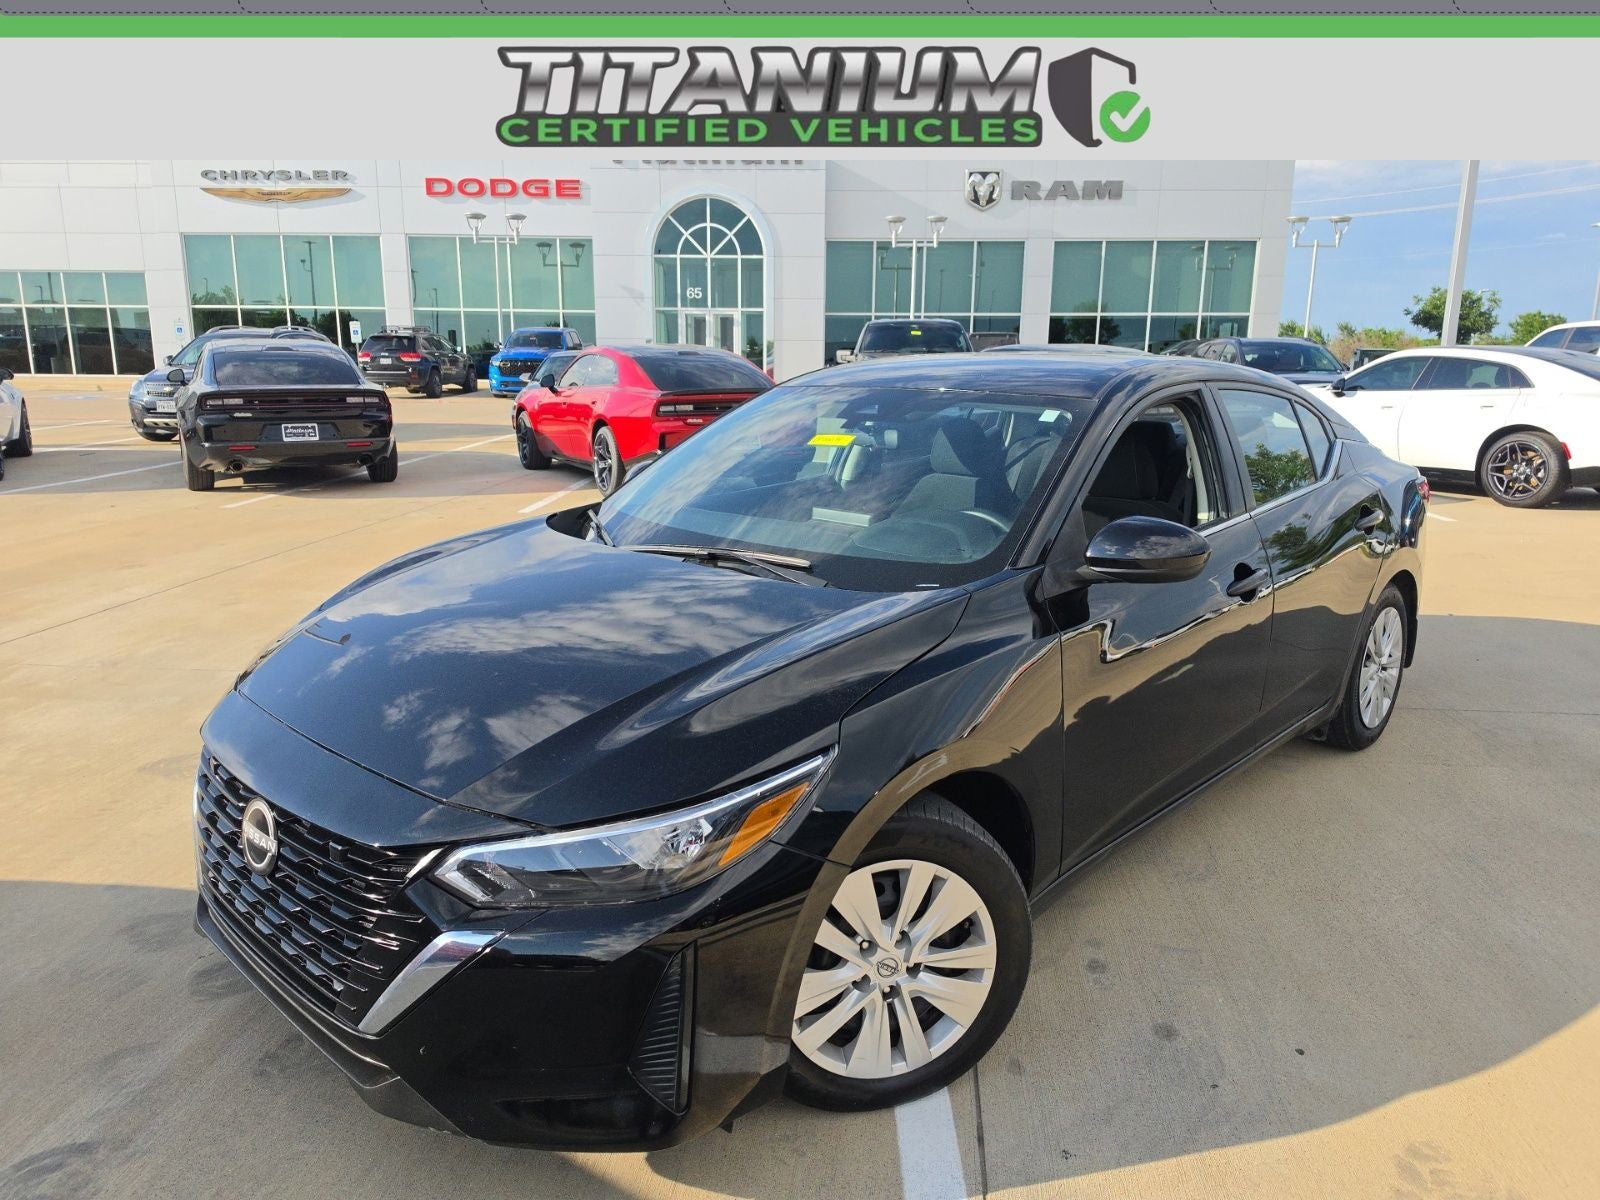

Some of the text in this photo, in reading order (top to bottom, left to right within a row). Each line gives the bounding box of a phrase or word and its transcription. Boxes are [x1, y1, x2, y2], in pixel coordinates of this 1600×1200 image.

[201, 169, 350, 181] CHRYSLER
[425, 177, 581, 198] DODGE
[1011, 180, 1124, 200] RAM
[686, 287, 702, 299] 65
